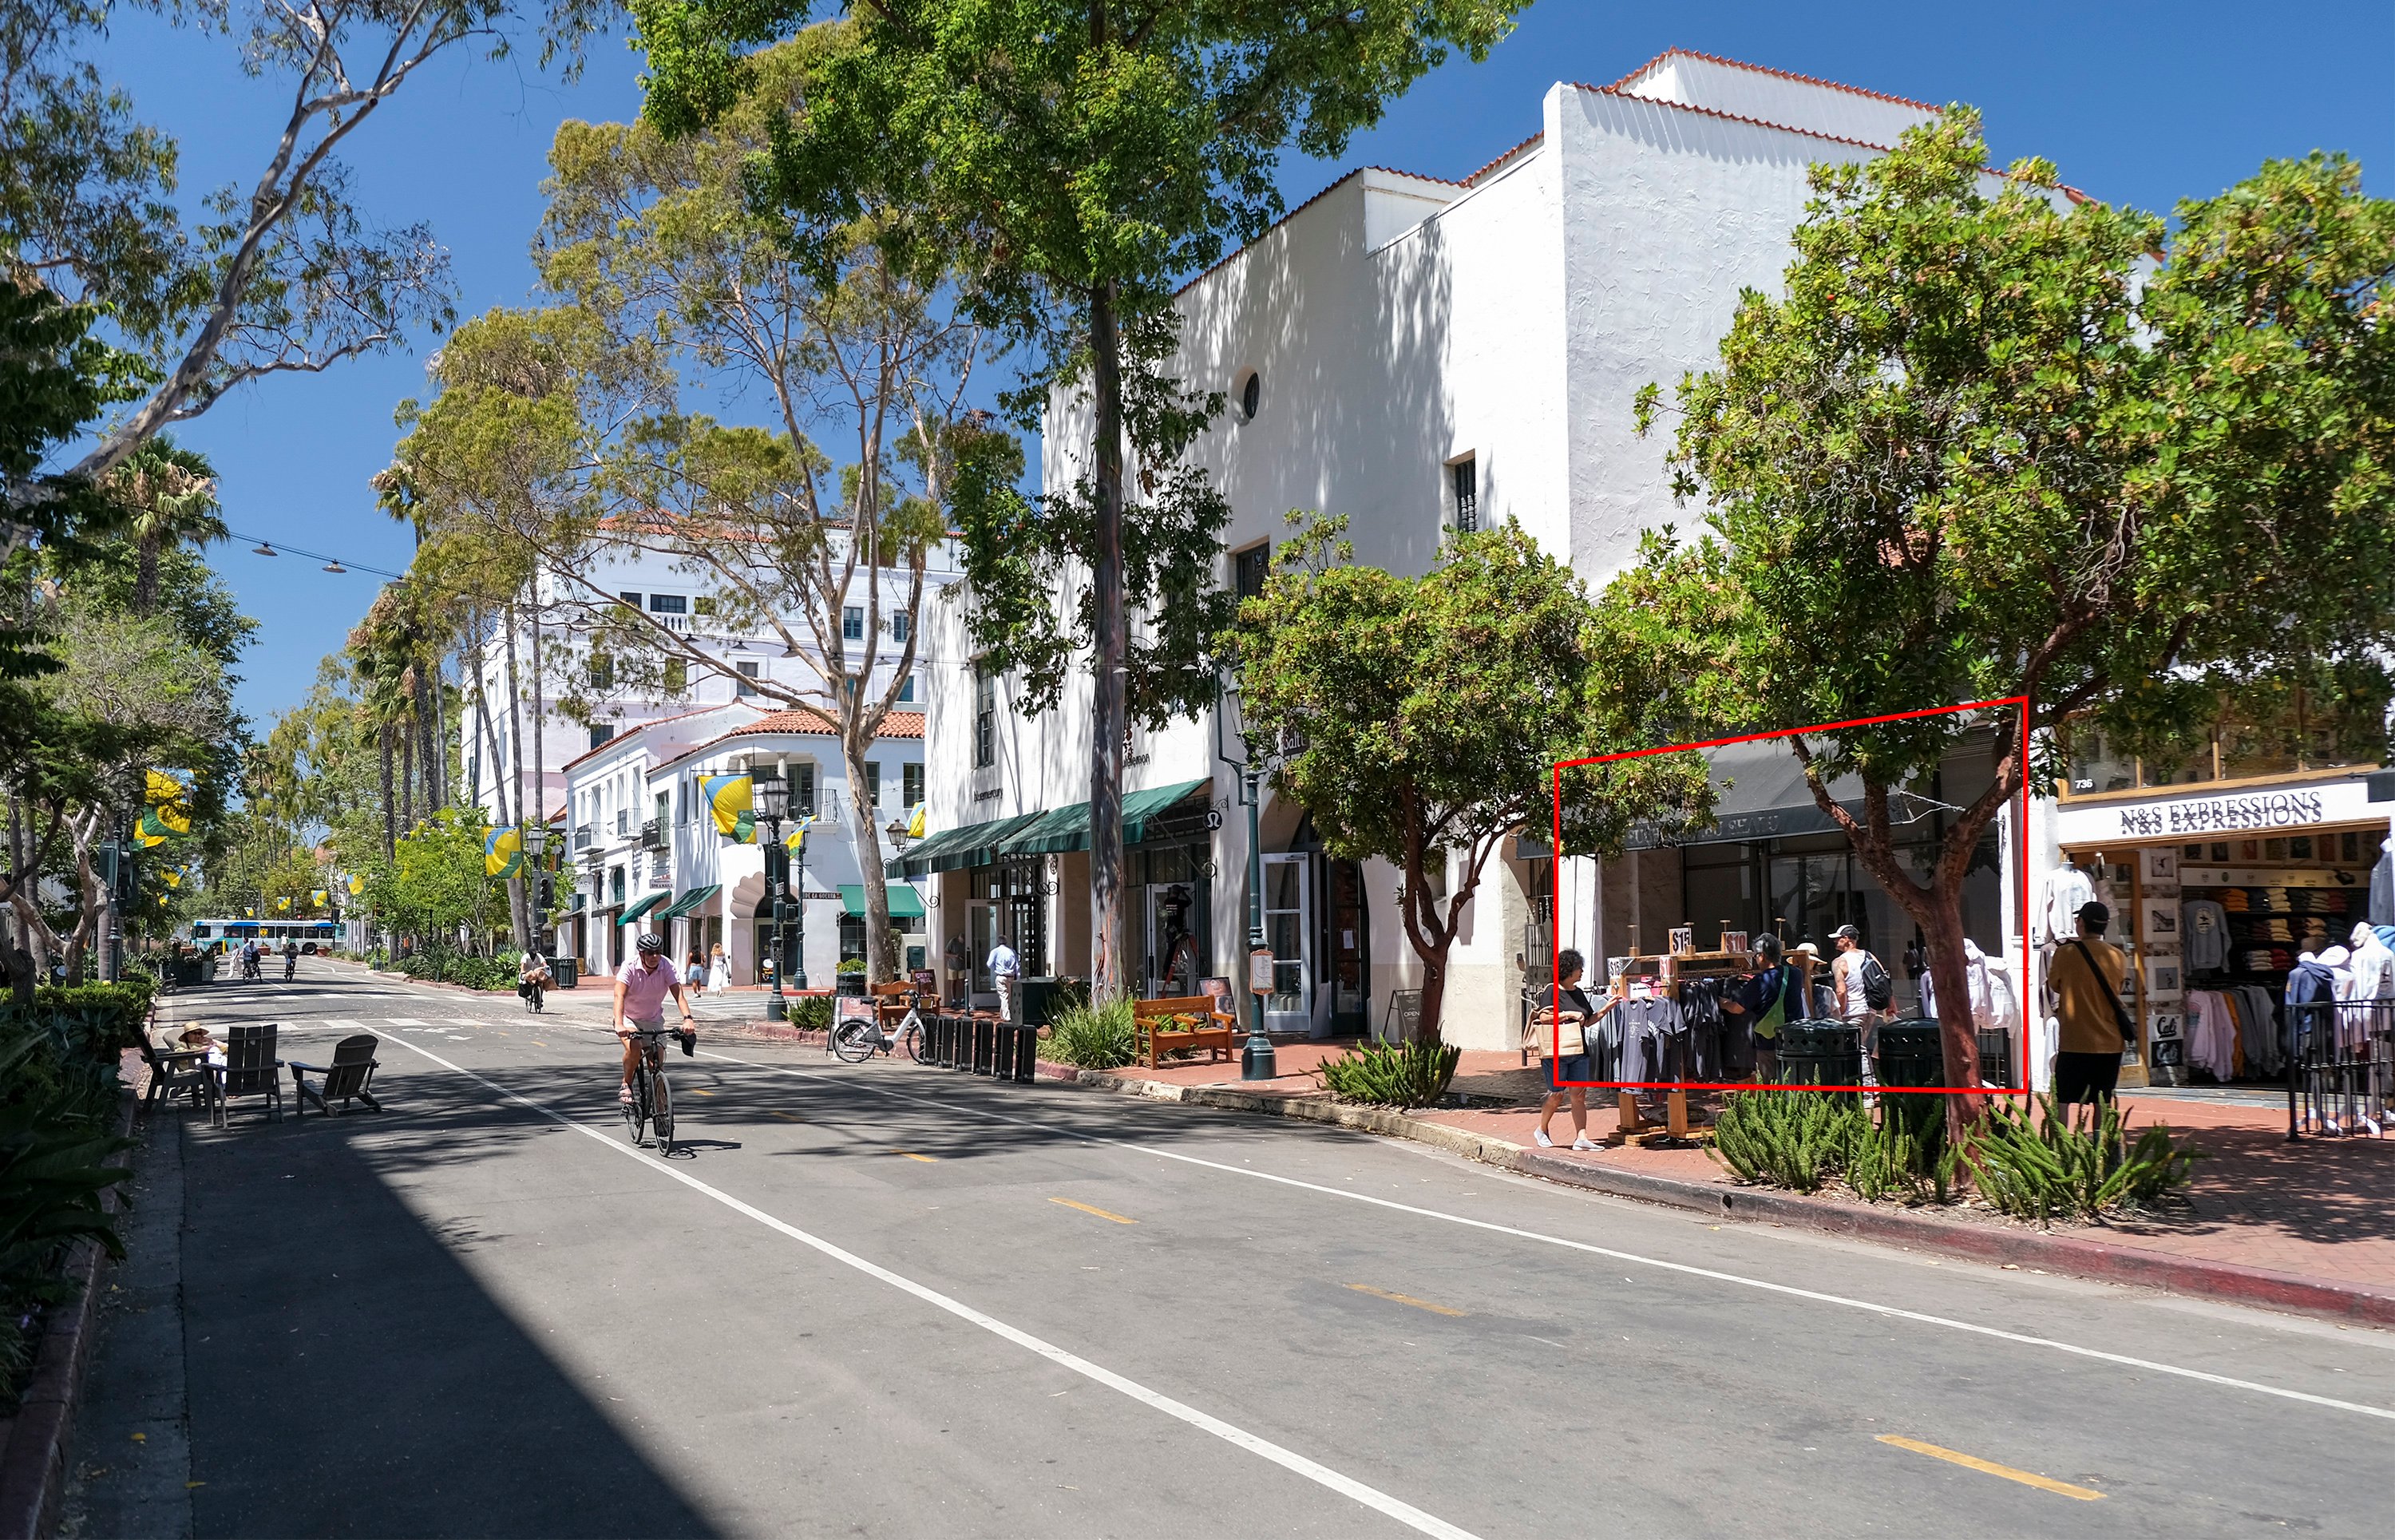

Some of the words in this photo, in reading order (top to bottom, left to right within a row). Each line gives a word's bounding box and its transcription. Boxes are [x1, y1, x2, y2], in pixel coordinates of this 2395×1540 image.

[1283, 730, 1300, 750] Salt
[2076, 779, 2092, 789] 736
[2120, 806, 2162, 826] N&S
[2169, 791, 2321, 821] EXPRESSIONS
[1673, 928, 1691, 953] $15
[1726, 934, 1746, 953] $10
[1609, 958, 1621, 976] $15
[1660, 957, 1673, 977] $10
